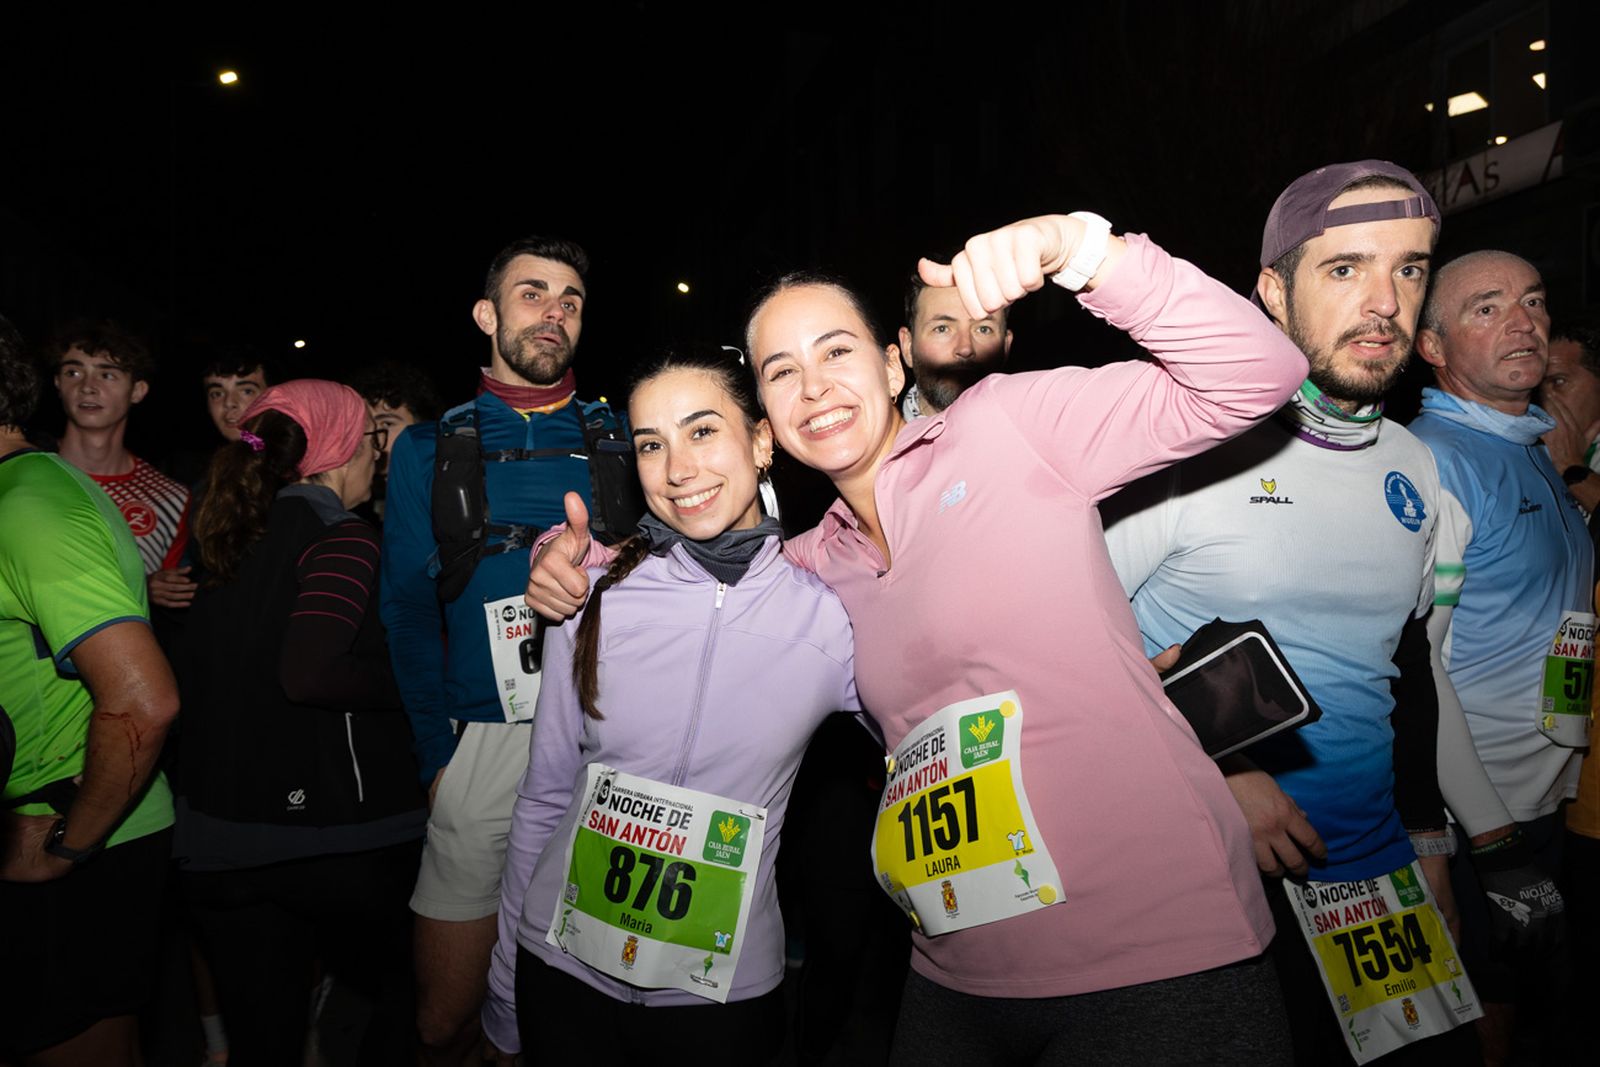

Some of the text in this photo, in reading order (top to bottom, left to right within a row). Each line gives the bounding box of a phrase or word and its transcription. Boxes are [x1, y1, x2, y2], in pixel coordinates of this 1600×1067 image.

[1249, 496, 1293, 504] SPALL
[506, 623, 532, 641] SAN
[1554, 643, 1578, 656] SAN
[898, 733, 946, 777] NOCHE DE
[886, 757, 948, 807] SAN ANTÓN
[608, 793, 666, 824] NOCHE
[667, 809, 694, 830] DE
[612, 785, 694, 812] CARRERA URBANA INTERNACIONAL
[588, 810, 687, 856] SAN ANTÓN
[898, 776, 979, 862] 1157
[925, 855, 961, 877] LAURA
[604, 846, 696, 921] 876
[1320, 878, 1380, 906] NOCHE DE
[1541, 889, 1564, 907] SAN
[1314, 909, 1342, 934] SAN
[1345, 890, 1389, 927] ANTÓN
[1333, 913, 1432, 987] 7554
[1384, 978, 1417, 997] Emilio
